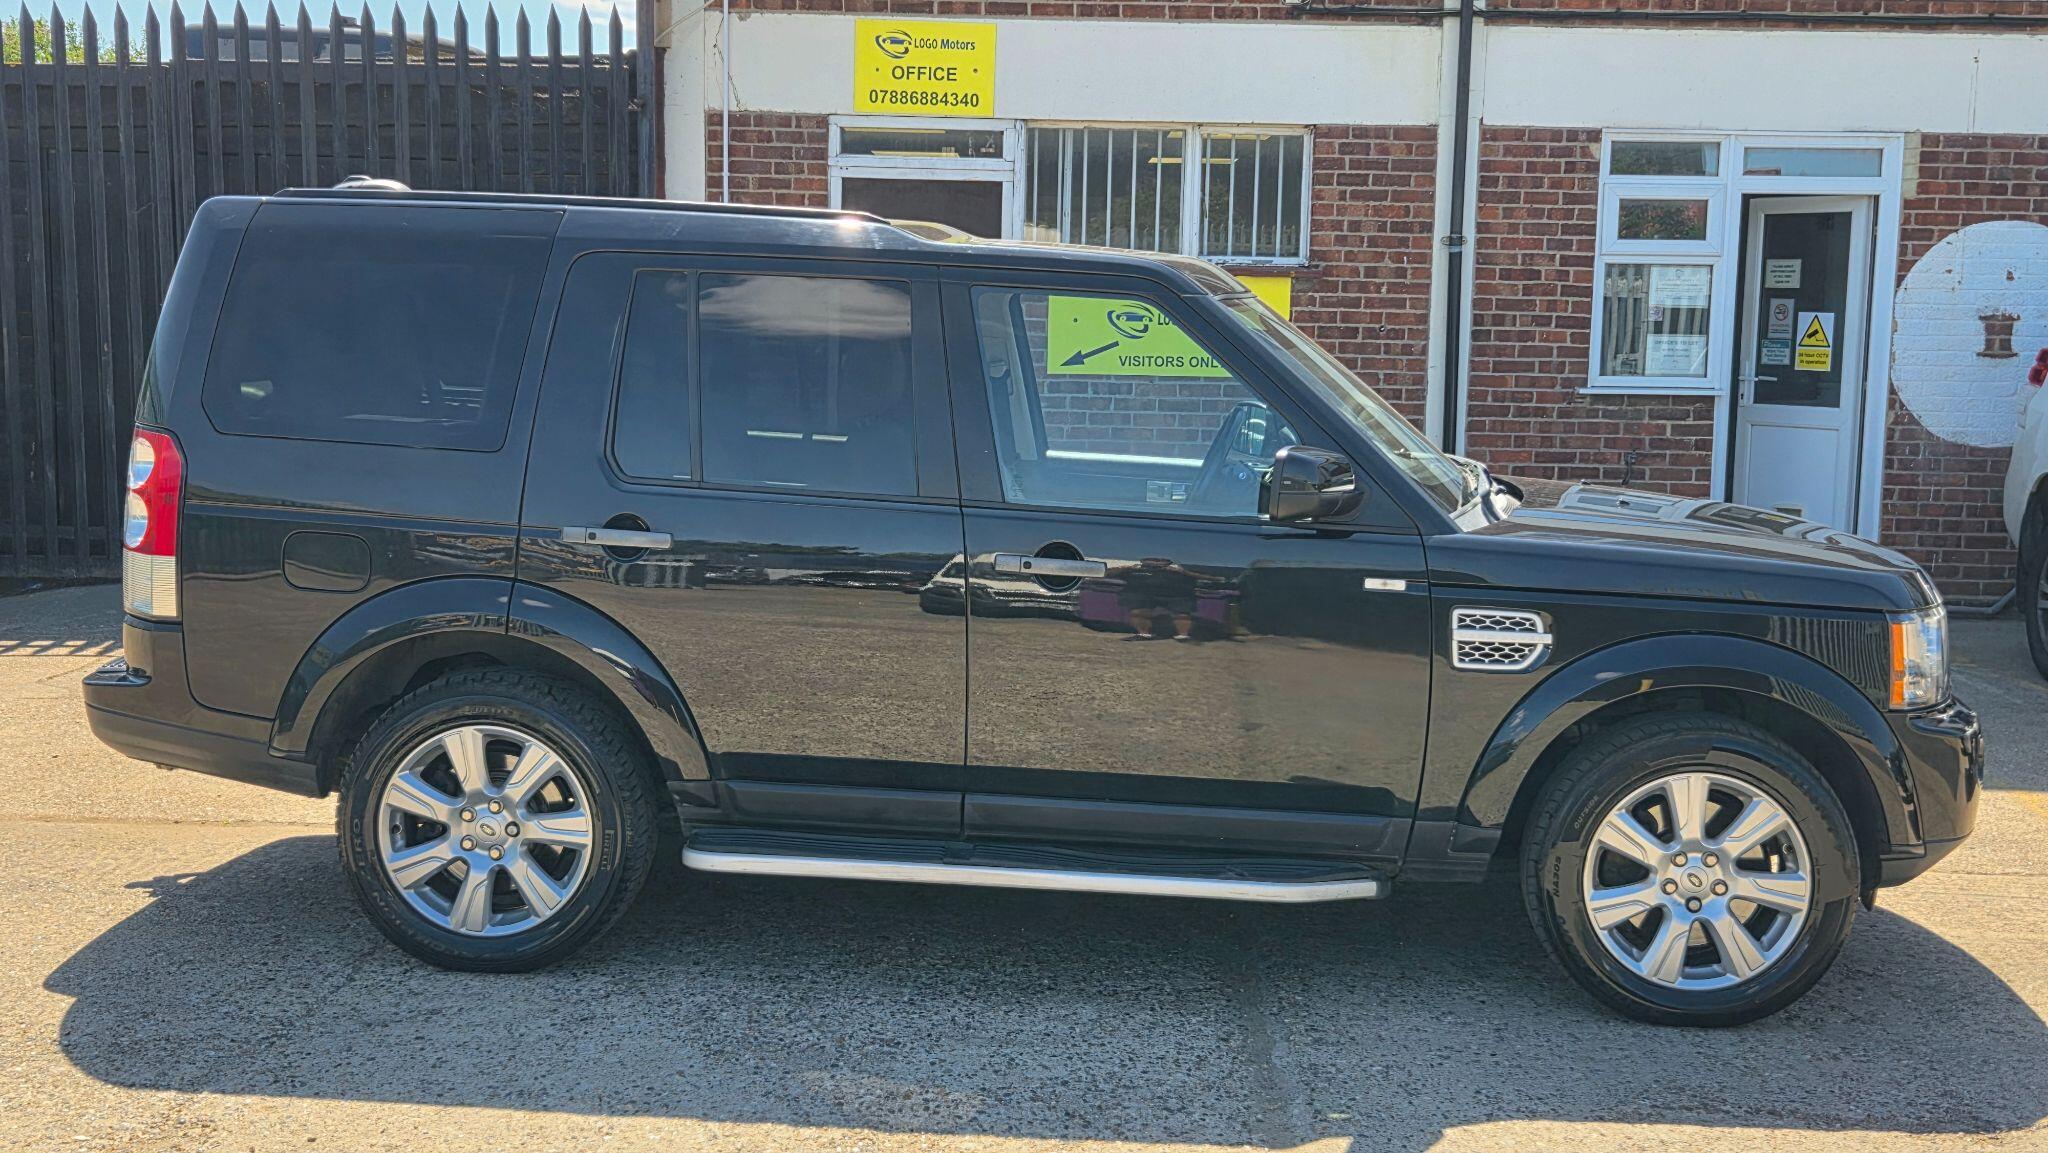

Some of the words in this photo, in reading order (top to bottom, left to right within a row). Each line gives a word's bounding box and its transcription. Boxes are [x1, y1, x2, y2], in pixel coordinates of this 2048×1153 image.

[914, 38, 938, 48] LOGO
[940, 38, 976, 51] Motors
[891, 65, 957, 81] OFFICE
[869, 89, 979, 107] 07886884340
[1158, 313, 1174, 325] LO
[1119, 355, 1184, 367] VISITORS
[1189, 356, 1223, 368] ONL
[1574, 795, 1600, 830] OUTSIDE
